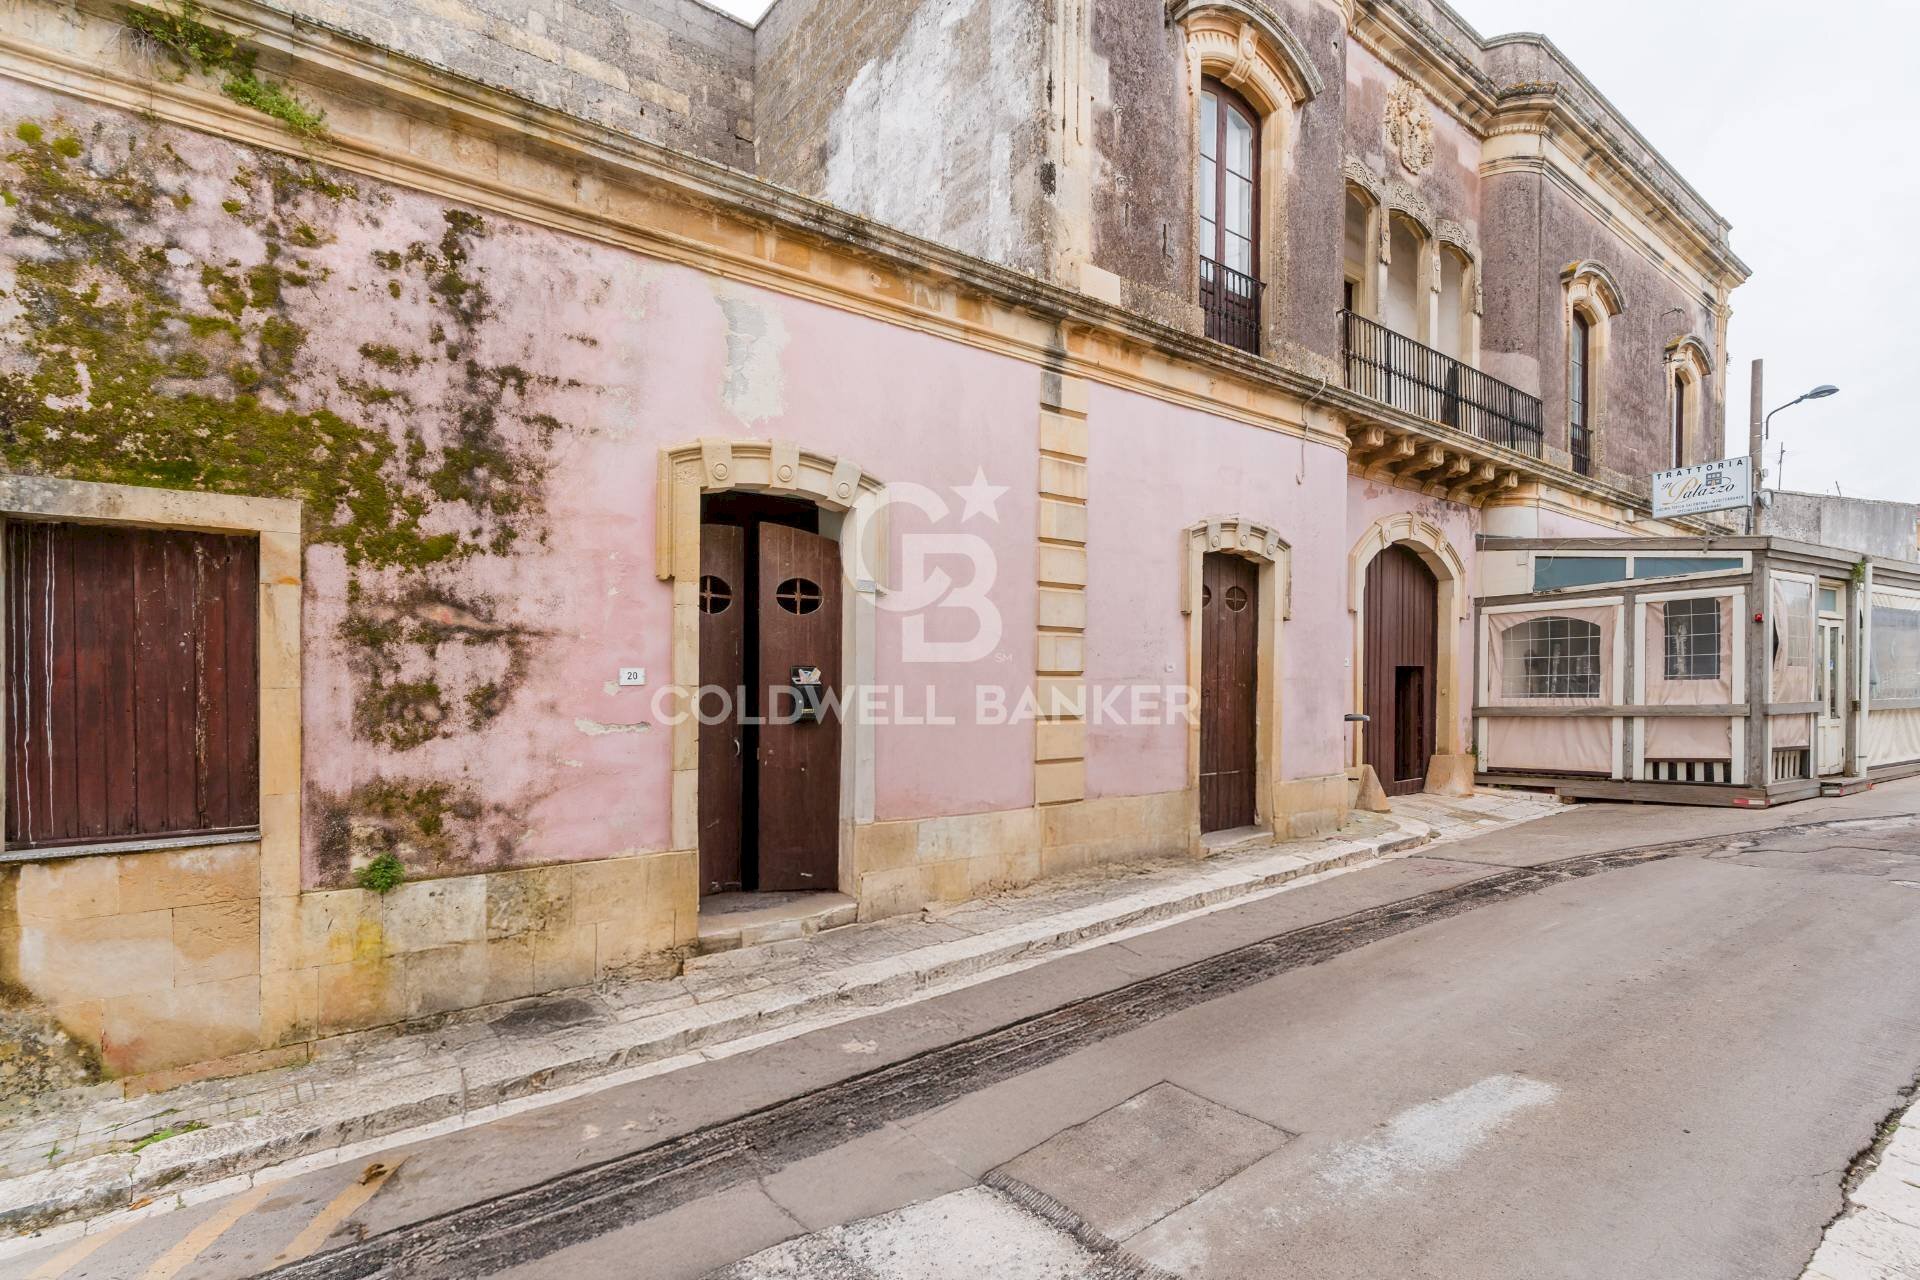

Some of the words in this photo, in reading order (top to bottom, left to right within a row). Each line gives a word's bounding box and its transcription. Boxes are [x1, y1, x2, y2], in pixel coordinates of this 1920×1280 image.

[1657, 459, 1743, 480] TRATTORIA
[1662, 477, 1735, 505] Palazzo
[627, 671, 638, 680] 20
